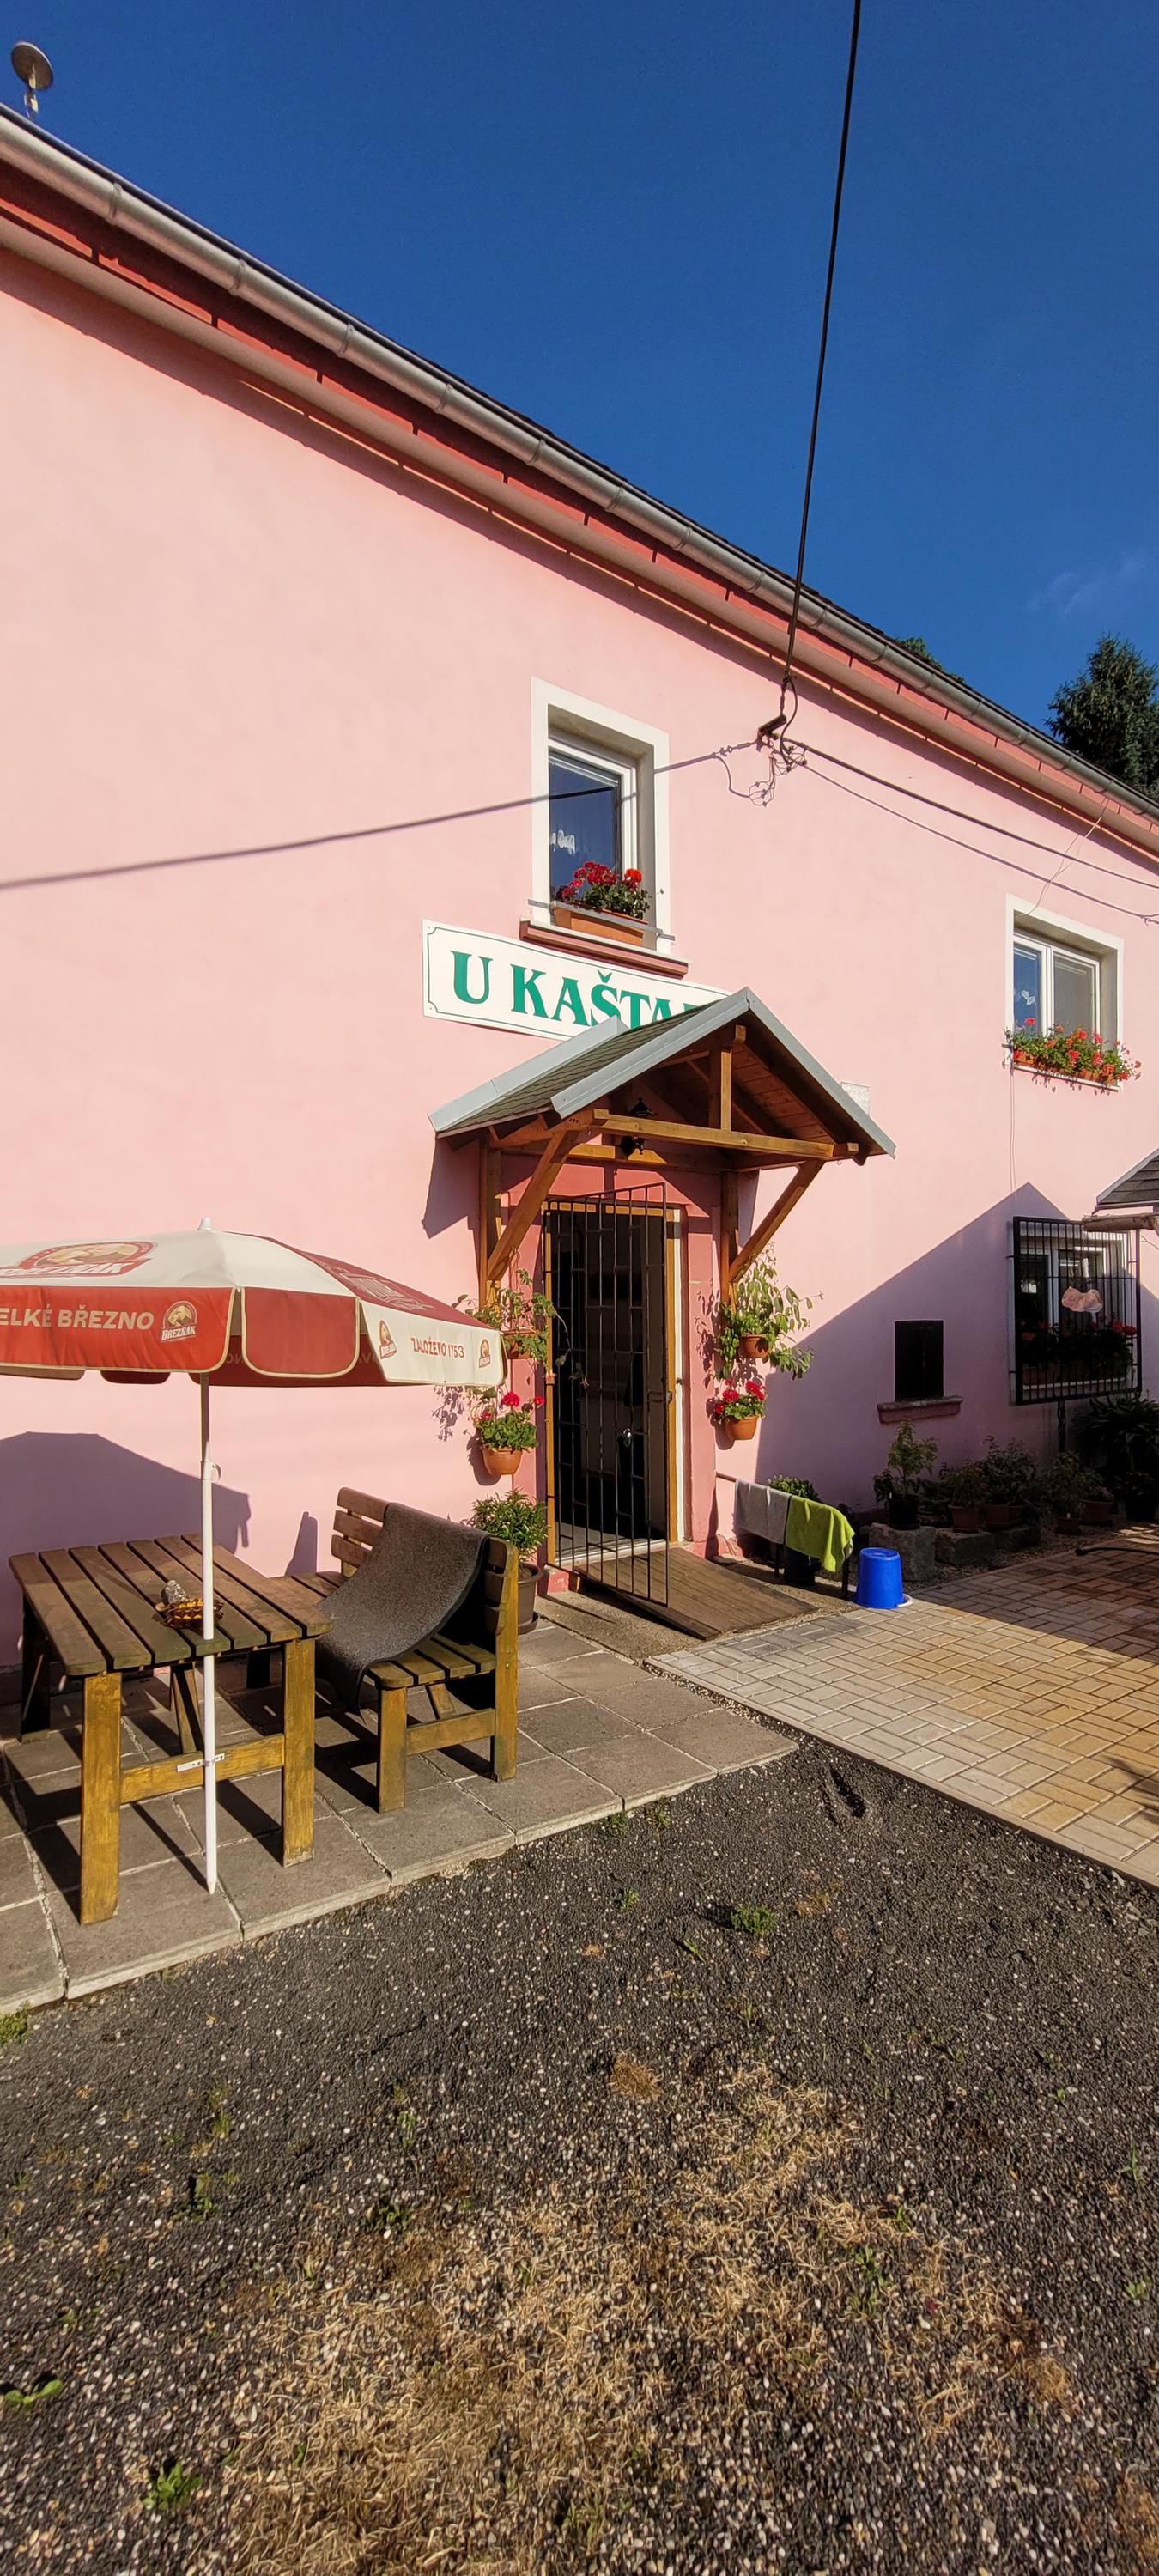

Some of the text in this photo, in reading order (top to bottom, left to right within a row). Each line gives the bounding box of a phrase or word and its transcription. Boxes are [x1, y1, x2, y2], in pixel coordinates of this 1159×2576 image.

[450, 951, 700, 1030] U KAŠTA
[0, 1303, 155, 1330] ELKÉ BŘEZNO
